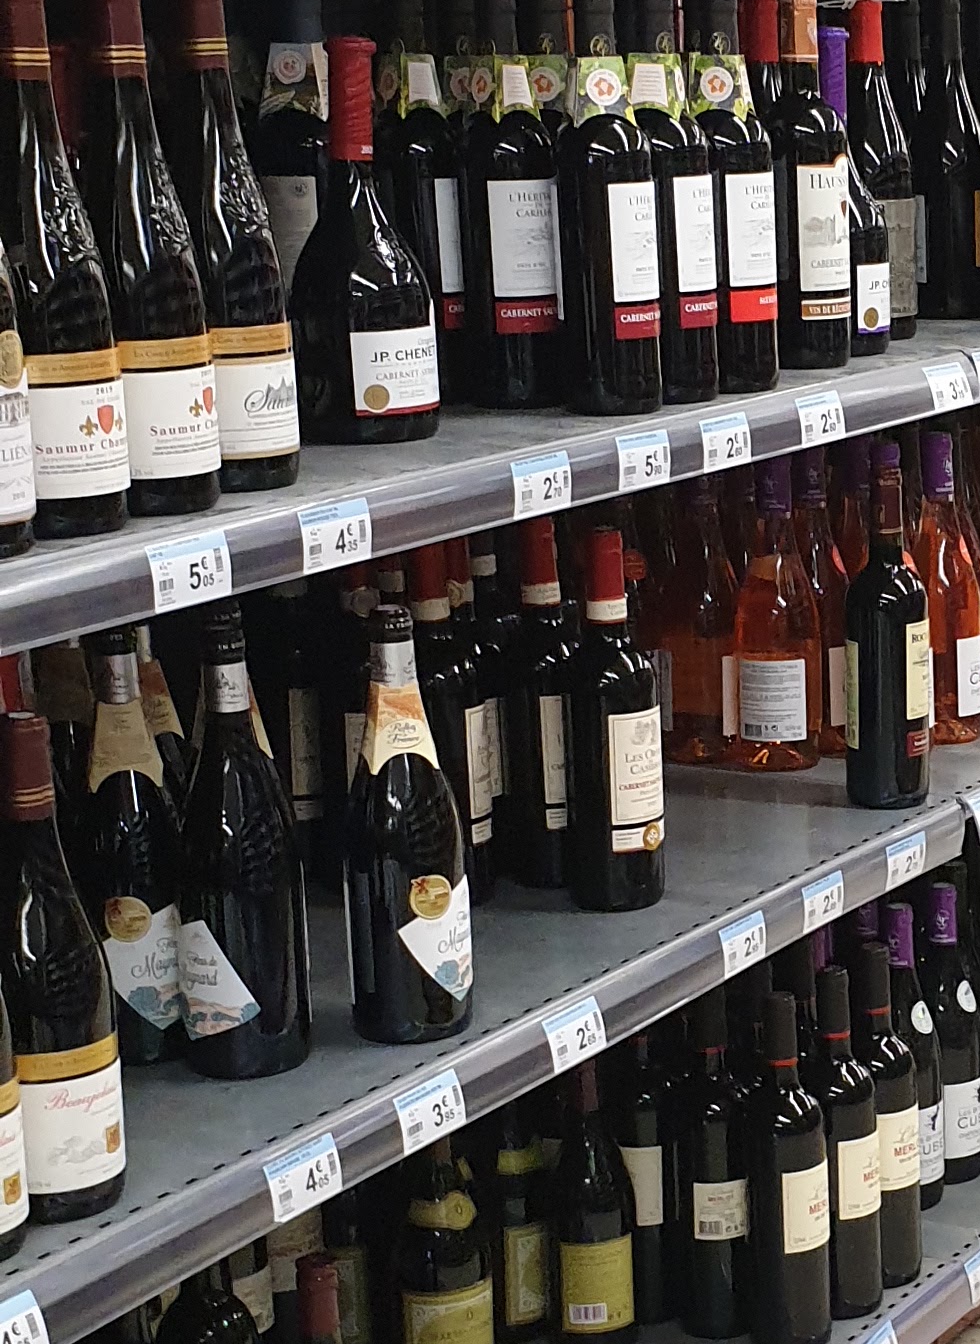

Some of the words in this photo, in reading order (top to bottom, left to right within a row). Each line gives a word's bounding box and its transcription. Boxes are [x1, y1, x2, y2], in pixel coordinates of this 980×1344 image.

[501, 307, 542, 318] CABERNET
[149, 423, 202, 438] Saumur
[35, 442, 95, 456] Saumur
[335, 523, 358, 554] 4€35
[188, 555, 215, 590] 5€05
